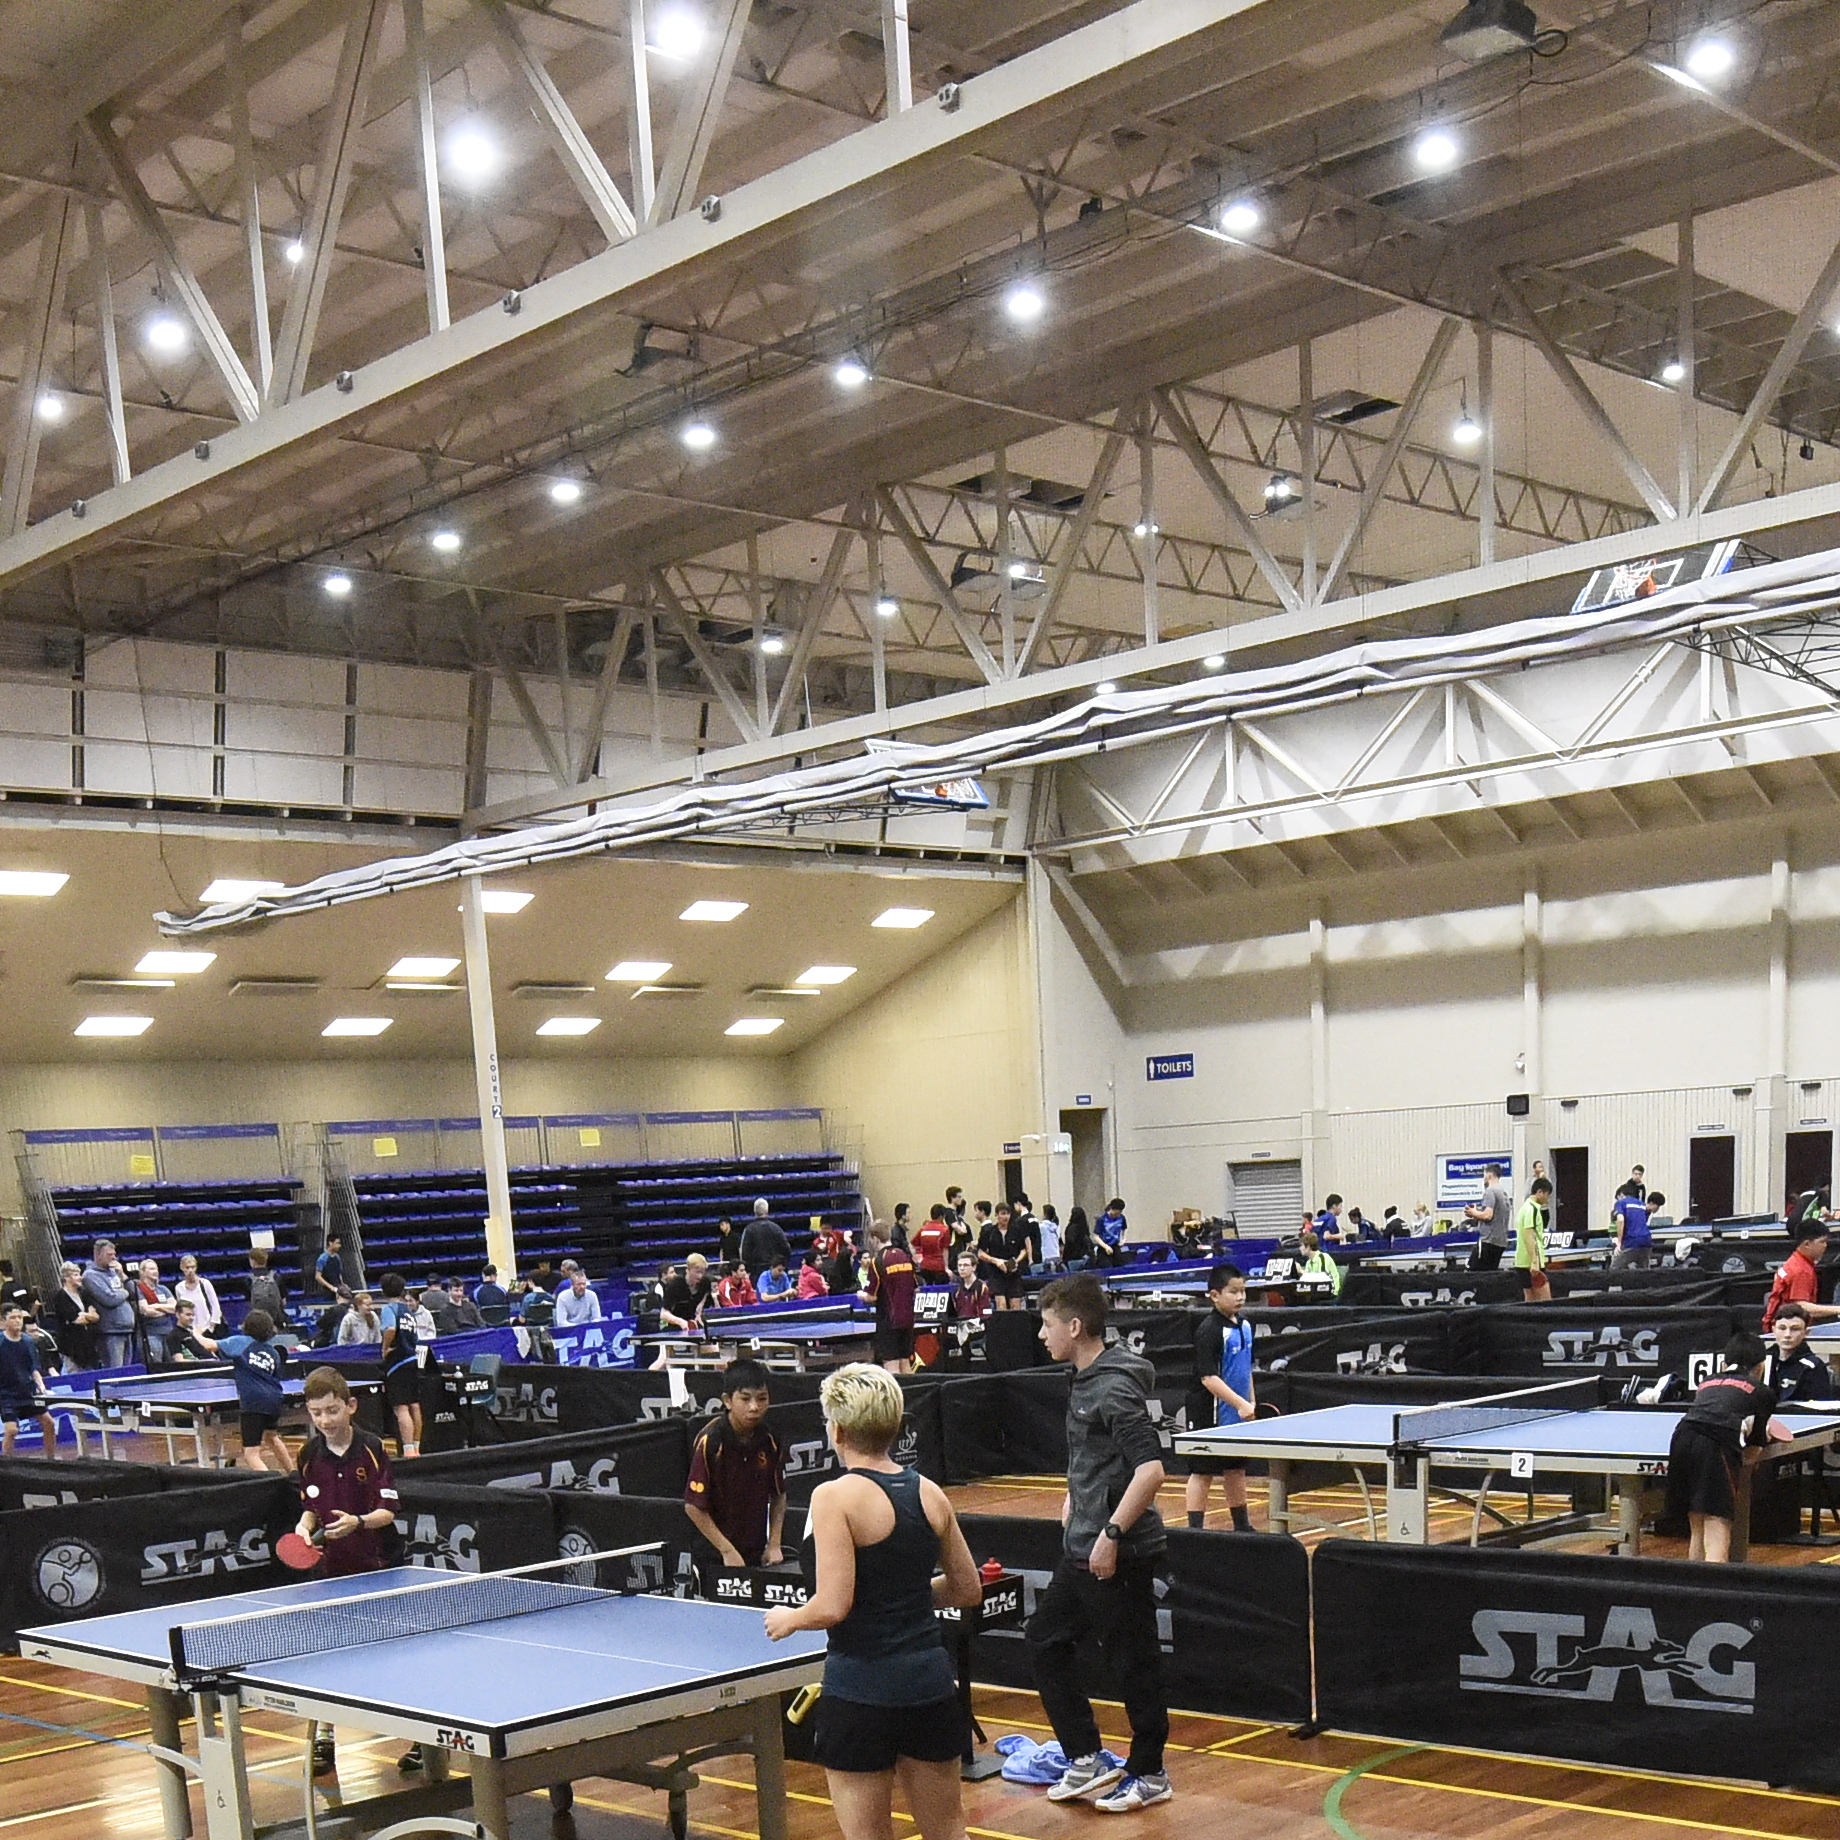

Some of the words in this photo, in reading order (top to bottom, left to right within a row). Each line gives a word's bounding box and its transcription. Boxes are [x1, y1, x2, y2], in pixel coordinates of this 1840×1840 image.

[489, 1054, 500, 1103] COURT
[1156, 1060, 1192, 1074] TOILETS
[493, 1106, 501, 1118] 2
[939, 1295, 947, 1311] 9
[554, 1328, 635, 1369] TAG
[1543, 1327, 1659, 1367] STAG
[1694, 1359, 1708, 1388] 6
[1518, 1457, 1527, 1473] 2
[1637, 1461, 1669, 1474] STA
[141, 1529, 271, 1585] STAG
[717, 1577, 753, 1598] STAG
[765, 1583, 809, 1605] STAG
[983, 1590, 1018, 1618] STAG
[1459, 1606, 1756, 1714] STAG
[436, 1729, 476, 1752] STAG
